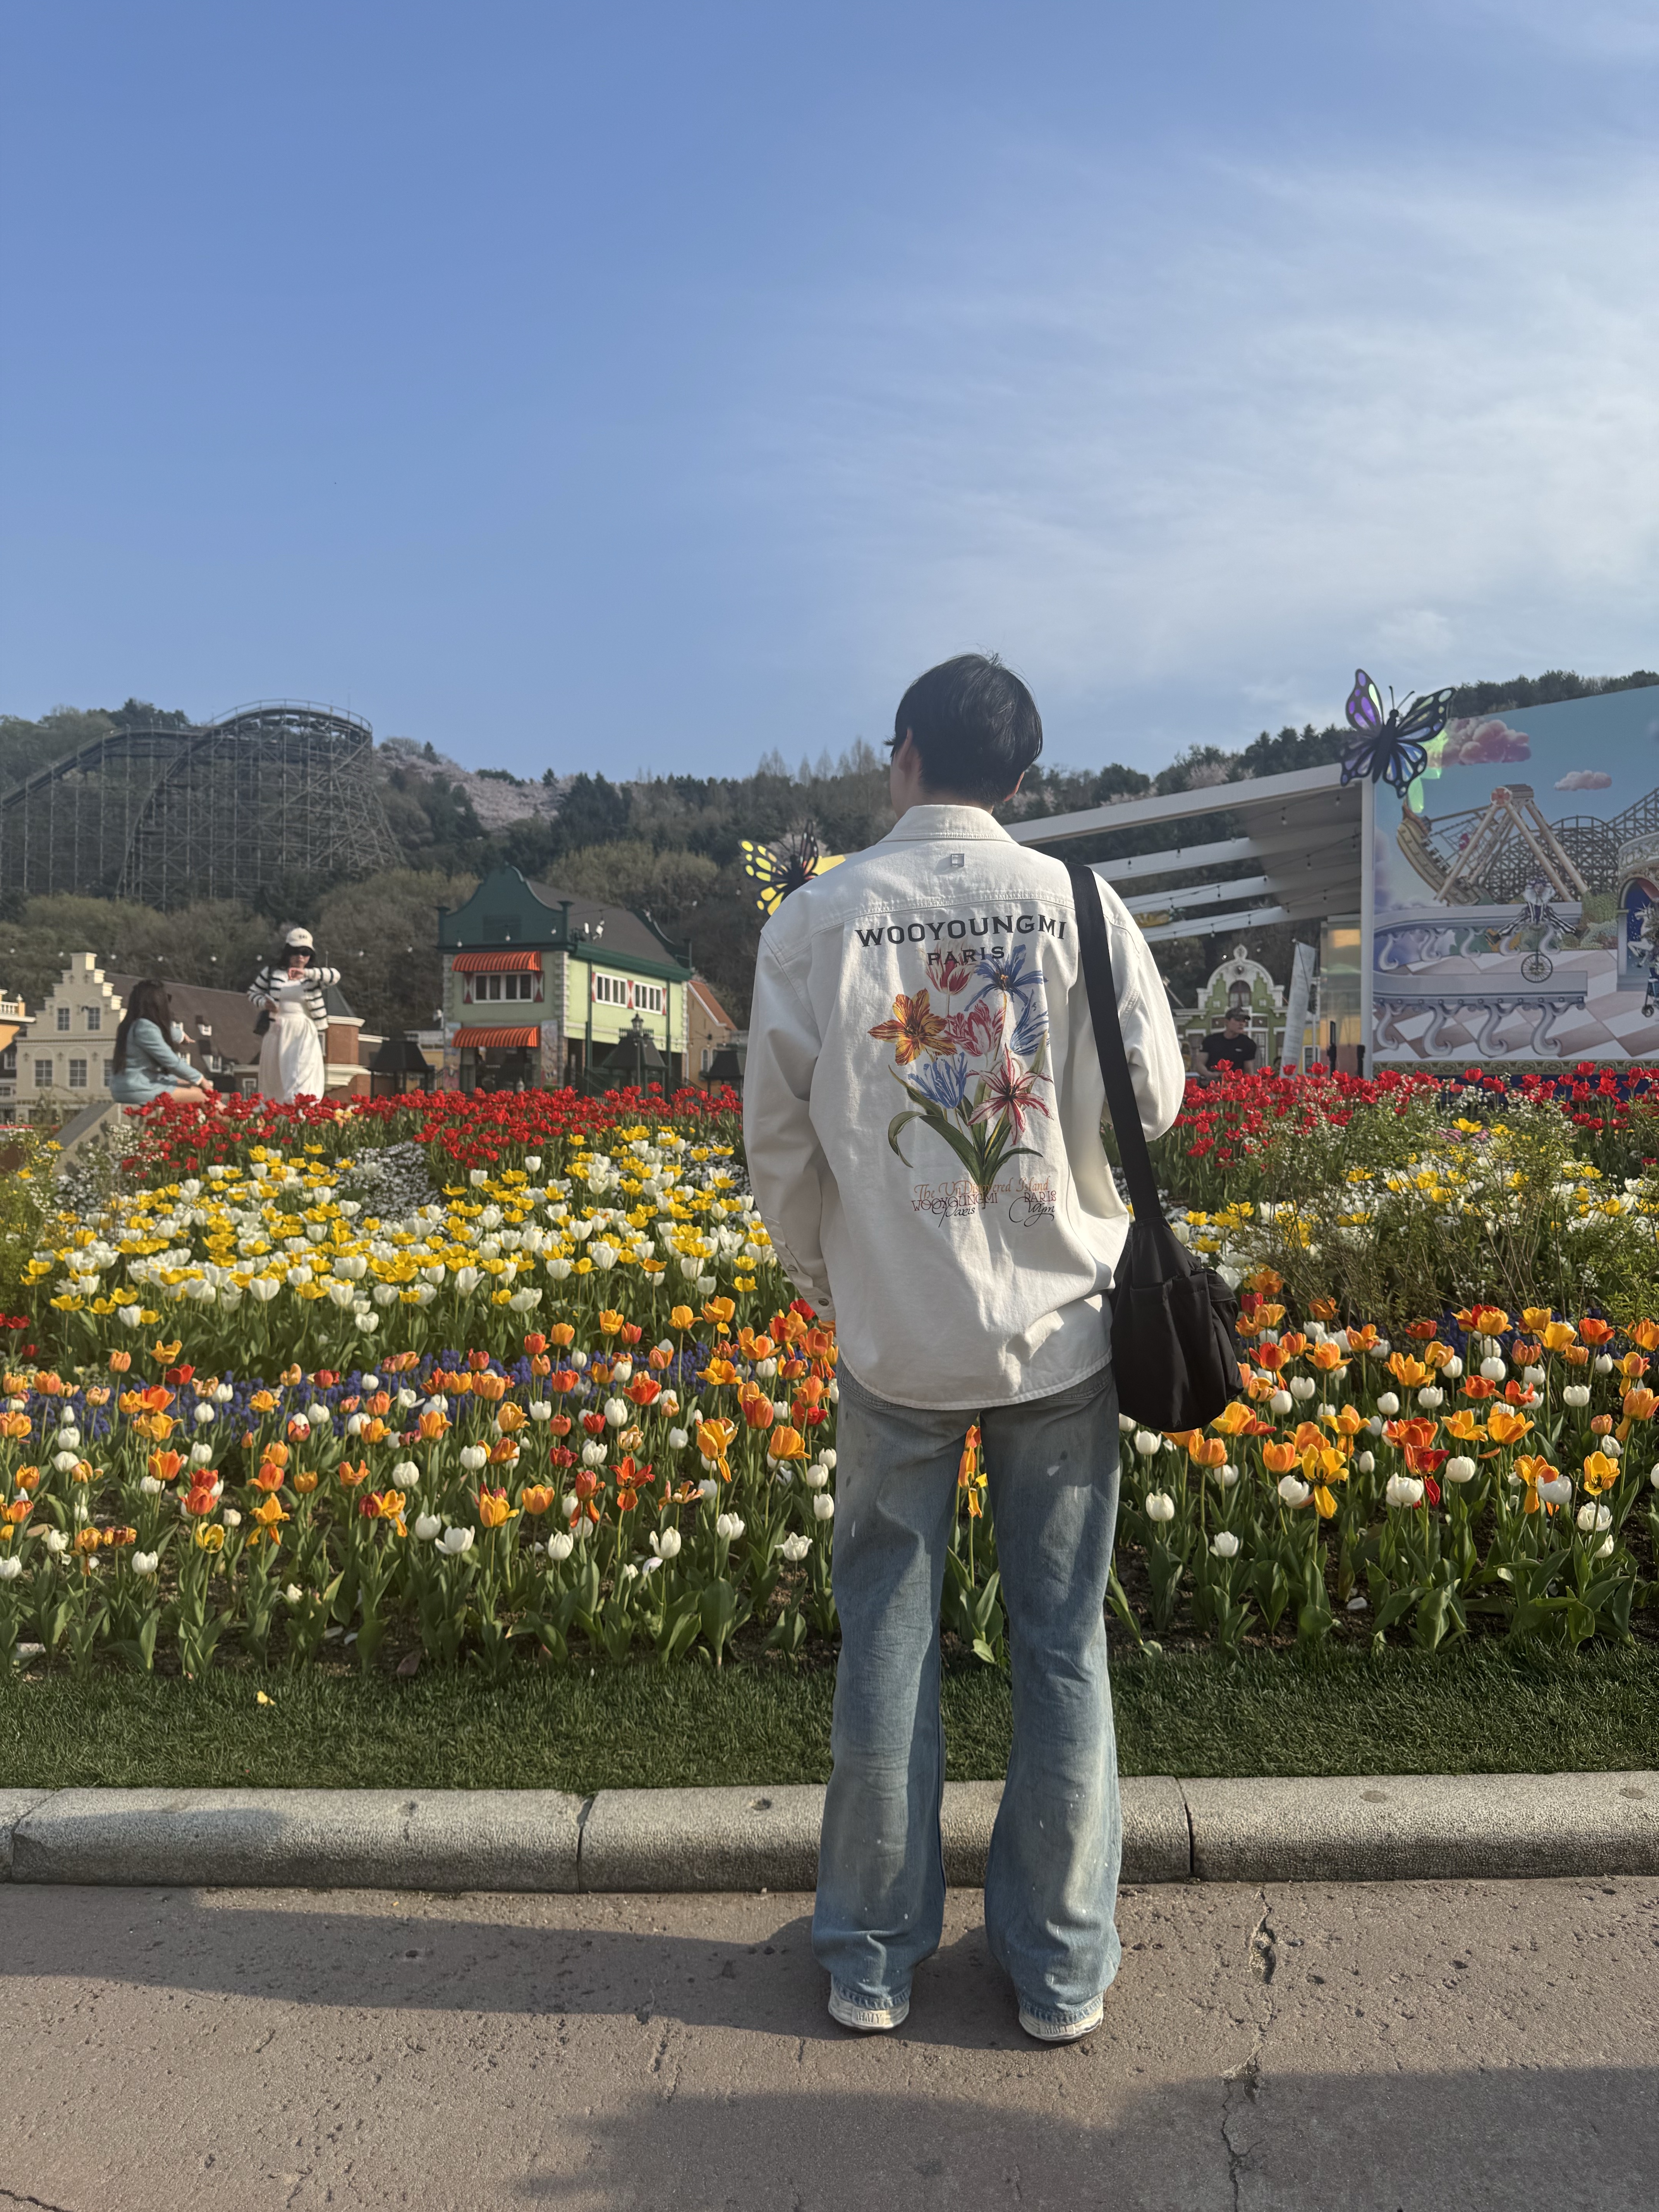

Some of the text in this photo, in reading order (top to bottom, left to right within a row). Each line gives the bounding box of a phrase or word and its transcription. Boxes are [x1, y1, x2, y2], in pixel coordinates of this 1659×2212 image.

[855, 914, 1066, 947] WOOYOUNGMI
[927, 946, 1005, 965] PARIS
[914, 1184, 935, 1200] The
[1016, 1175, 1050, 1192] Island
[911, 1190, 1056, 1211] WOOYOUNGMI PARIS
